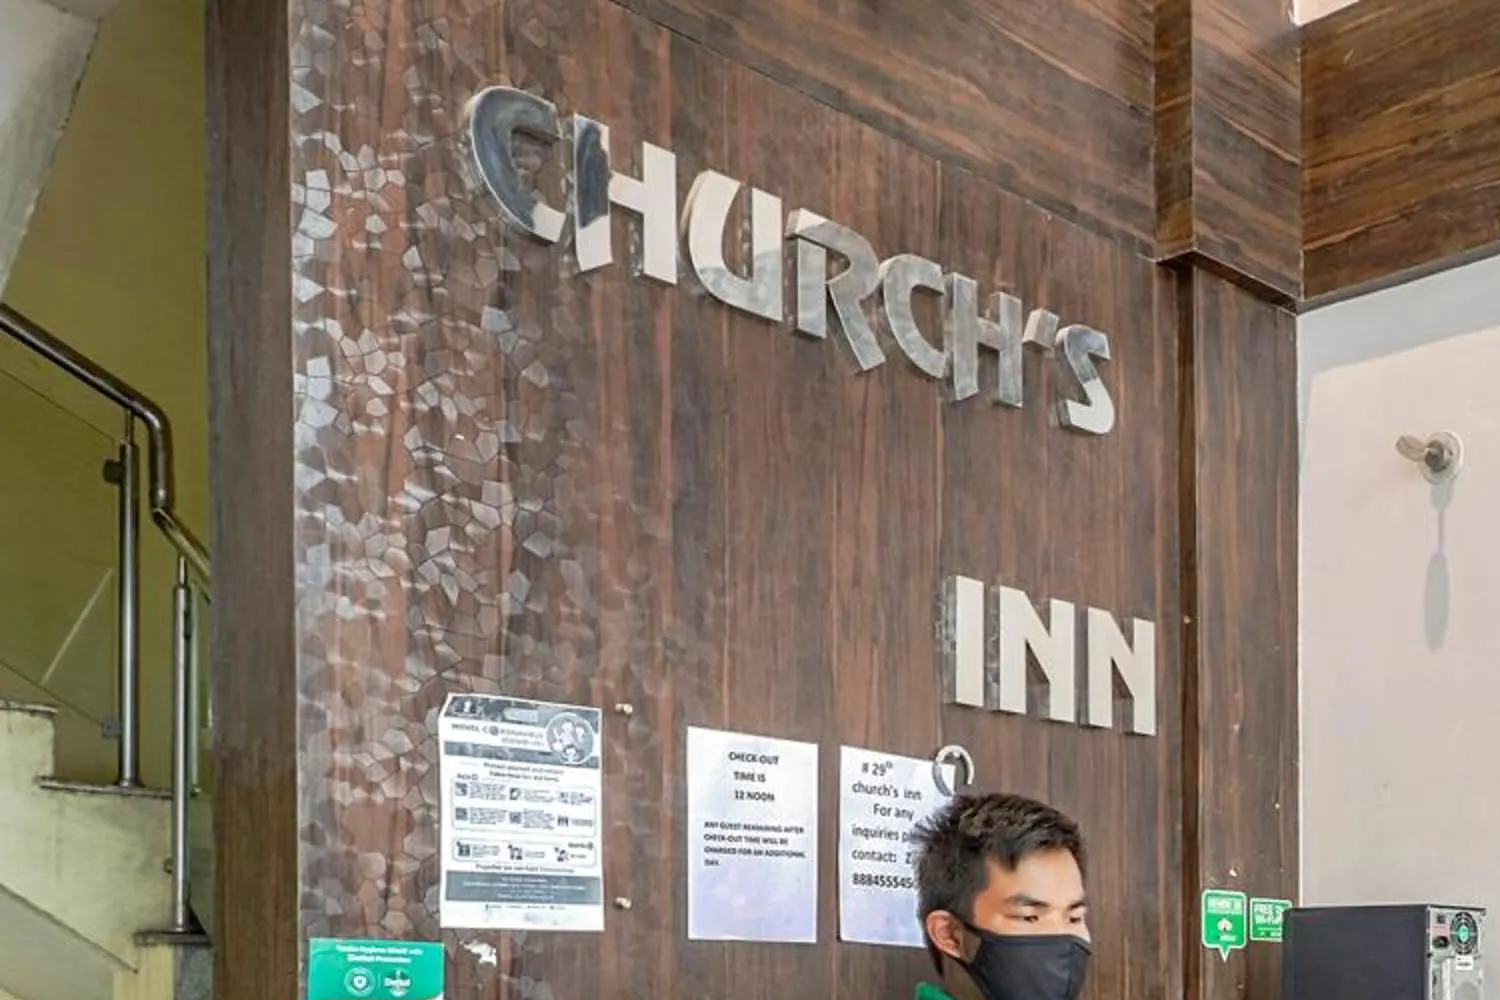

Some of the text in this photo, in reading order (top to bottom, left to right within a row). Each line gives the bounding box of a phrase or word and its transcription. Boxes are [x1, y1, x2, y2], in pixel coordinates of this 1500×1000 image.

[463, 84, 1117, 437] CHURCH'S
[947, 574, 1157, 737] INN
[733, 771, 767, 783] TIME IS
[735, 789, 775, 802] 12 NOON
[852, 780, 922, 801] church's inn
[873, 803, 914, 821] For any
[851, 824, 899, 841] inquiries
[851, 848, 897, 864] contact:
[852, 872, 917, 889] 888455545
